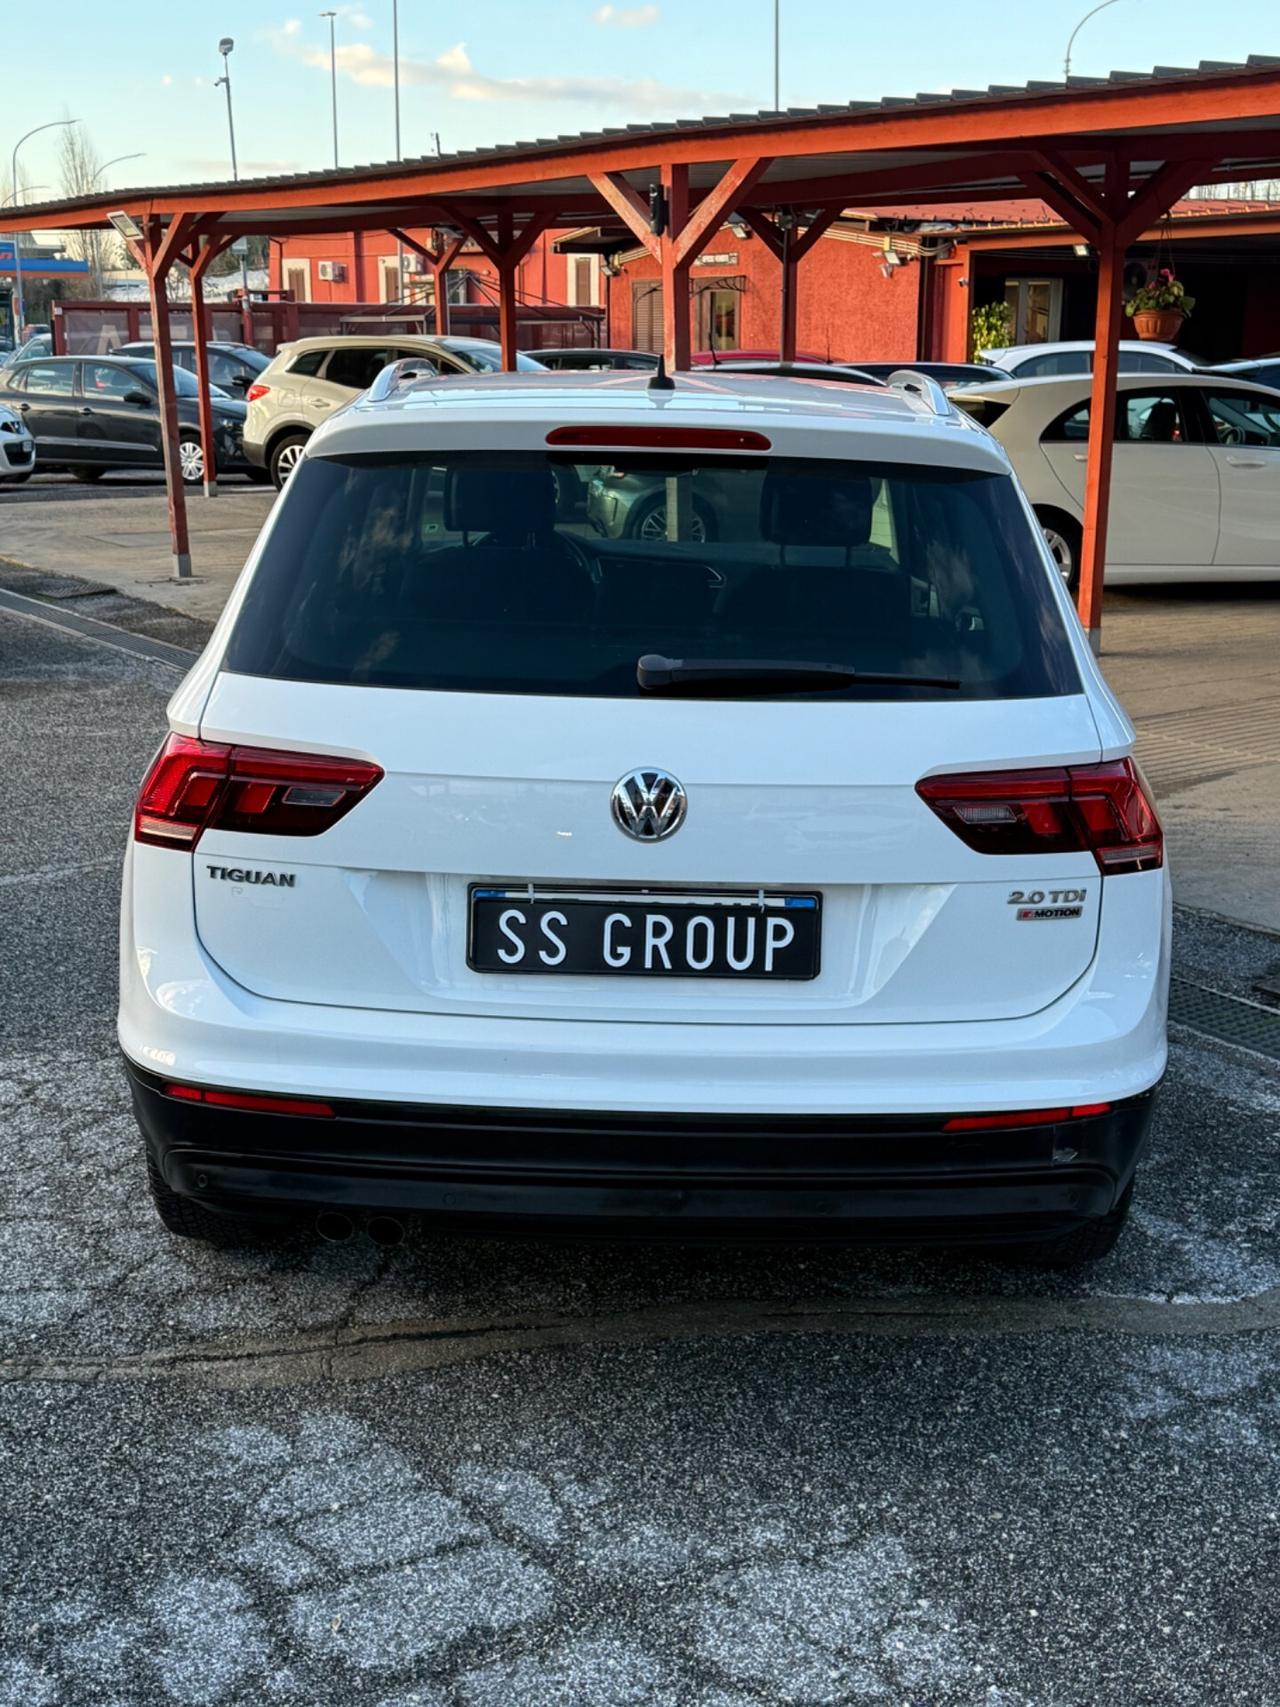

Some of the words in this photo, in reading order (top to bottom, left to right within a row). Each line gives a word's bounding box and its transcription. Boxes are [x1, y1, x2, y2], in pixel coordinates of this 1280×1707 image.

[613, 768, 686, 842] VW
[206, 865, 296, 888] TIGUAN
[1048, 889, 1087, 903] TDI
[497, 909, 568, 966] SS
[603, 912, 795, 972] GROUP
